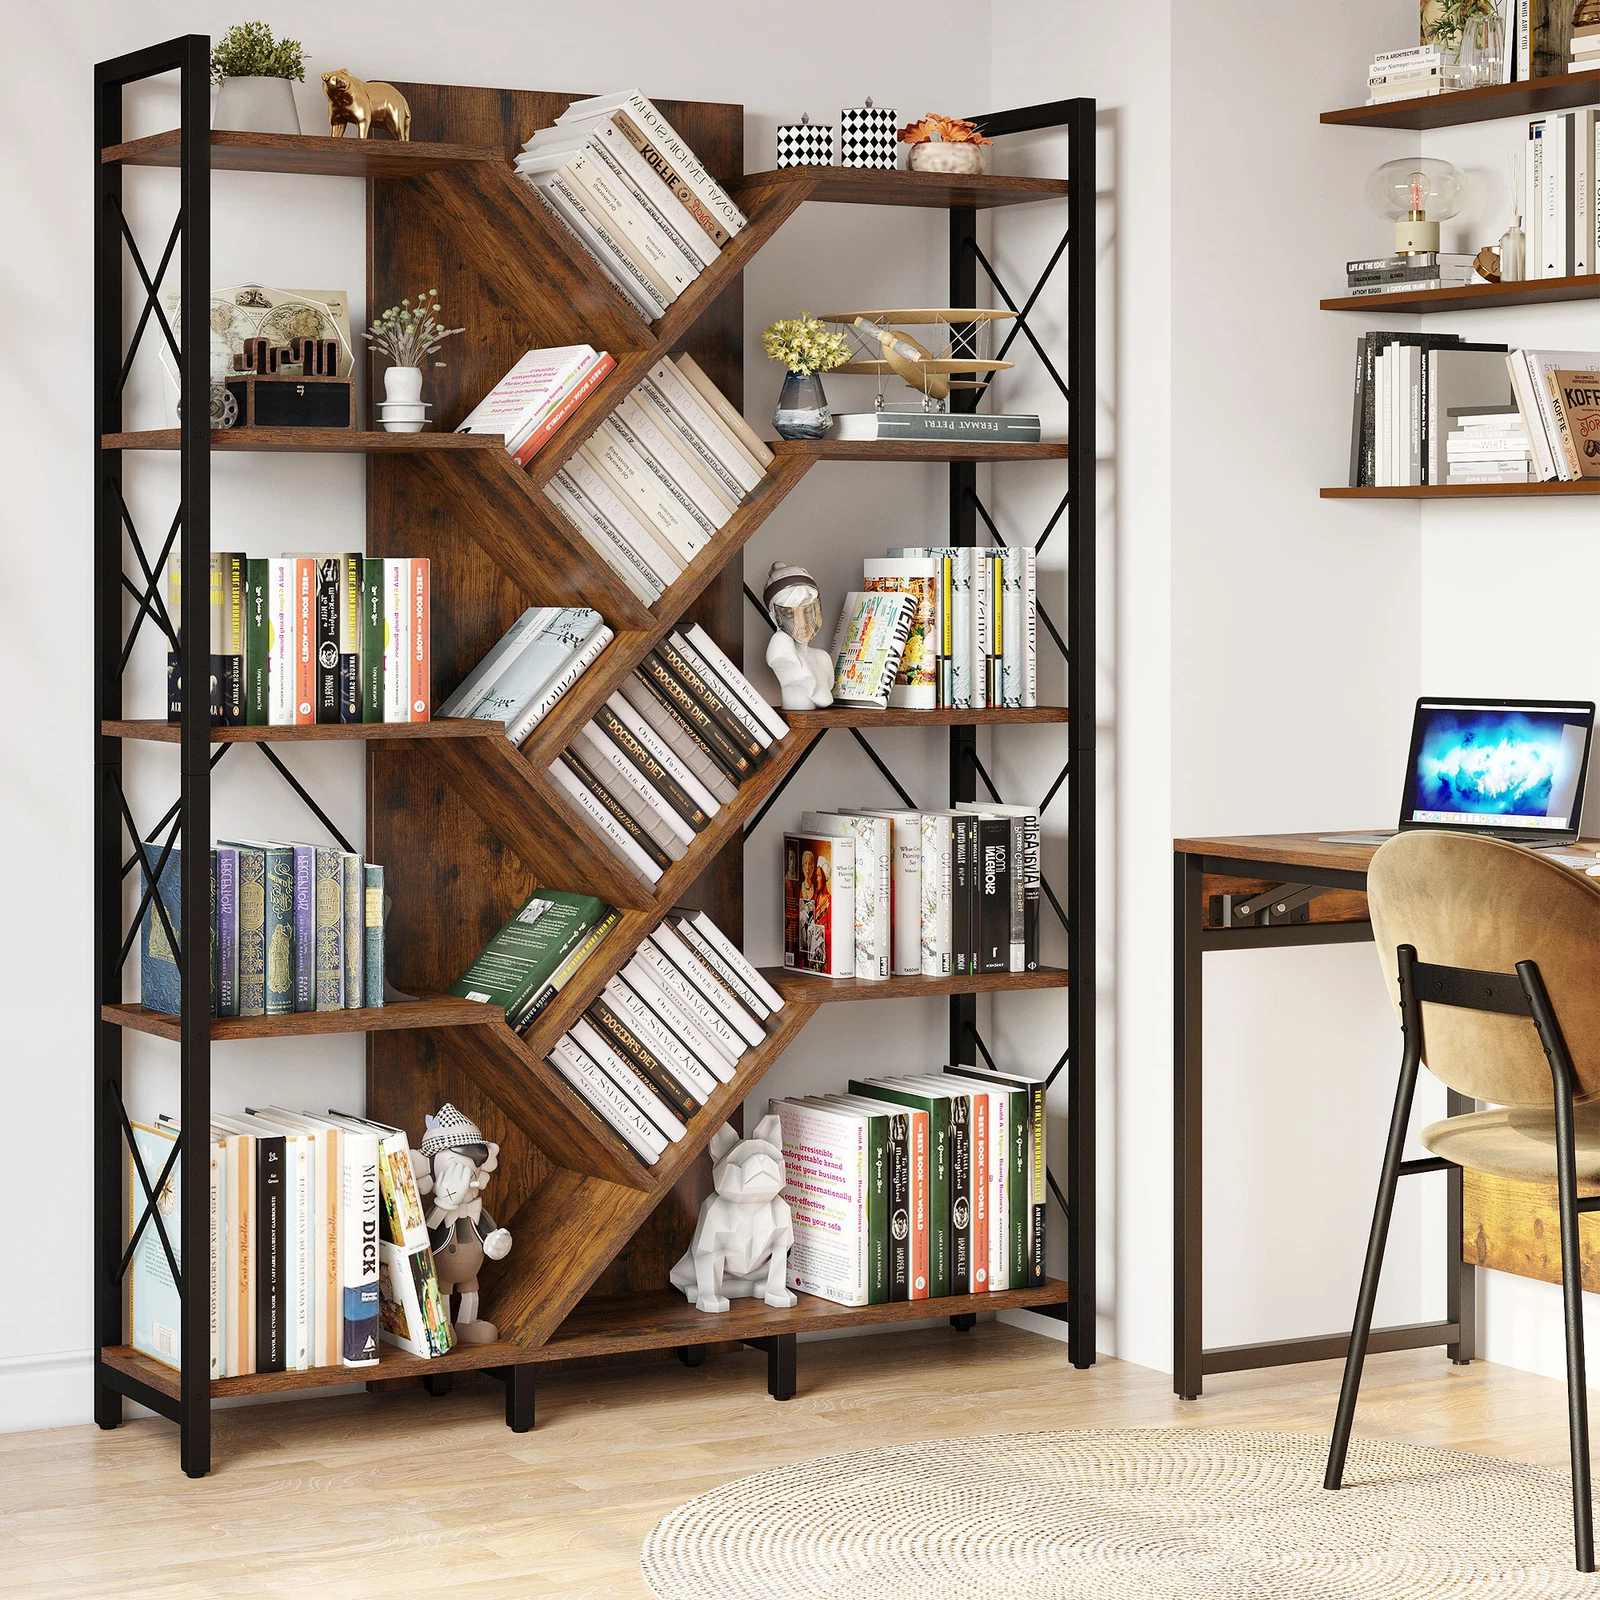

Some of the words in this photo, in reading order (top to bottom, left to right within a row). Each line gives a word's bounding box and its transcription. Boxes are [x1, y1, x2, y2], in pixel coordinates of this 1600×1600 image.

[1390, 49, 1420, 60] ARCHITECTURE
[1373, 65, 1387, 73] Oscar
[1388, 61, 1410, 69] Niemeyer
[1364, 262, 1373, 270] THE
[1373, 261, 1386, 269] EDGE
[1390, 284, 1411, 292] CLOCKWORK
[924, 420, 955, 430] PETRI
[1551, 397, 1567, 433] KOFFIE
[958, 421, 1000, 432] FERMAT
[716, 658, 743, 686] OLIVER
[738, 682, 762, 706] TWIST
[700, 689, 725, 714] DIET
[688, 704, 712, 729] DIET
[635, 724, 667, 758] OLIVER
[609, 752, 642, 786] OLIVER
[642, 756, 667, 782] DIET
[576, 790, 608, 824] OLIVER
[594, 921, 609, 936] GIRL
[684, 958, 715, 990] OLIVER
[534, 986, 554, 1008] ANKUSH
[519, 1005, 537, 1025] SAIKIA
[654, 995, 686, 1029] OLIVER
[635, 1048, 659, 1072] DIET
[604, 1054, 637, 1089] OLIVER
[1033, 1089, 1041, 1103] THE
[1033, 1105, 1041, 1121] GIRL
[1033, 1123, 1041, 1143] FROM
[799, 1143, 833, 1159] irresistible
[962, 1139, 968, 1151] To
[824, 1159, 843, 1171] brand
[954, 1130, 962, 1189] Mockingbird
[785, 1162, 802, 1172] arket
[802, 1166, 818, 1176] your
[818, 1169, 846, 1184] business
[892, 1146, 901, 1202] Mockingbird
[362, 1164, 375, 1216] MOBY
[804, 1181, 852, 1203] internationally
[1033, 1180, 1041, 1201] HILLS
[784, 1193, 826, 1211] cost-effective
[795, 1211, 811, 1223] from
[811, 1217, 827, 1227] your
[827, 1222, 842, 1232] sofa
[362, 1219, 375, 1276] DICK
[895, 1247, 904, 1270] HARPER
[957, 1237, 965, 1263] HARPER
[895, 1270, 904, 1283] LEE
[957, 1262, 965, 1276] LEE
[270, 1328, 276, 1337] DU
